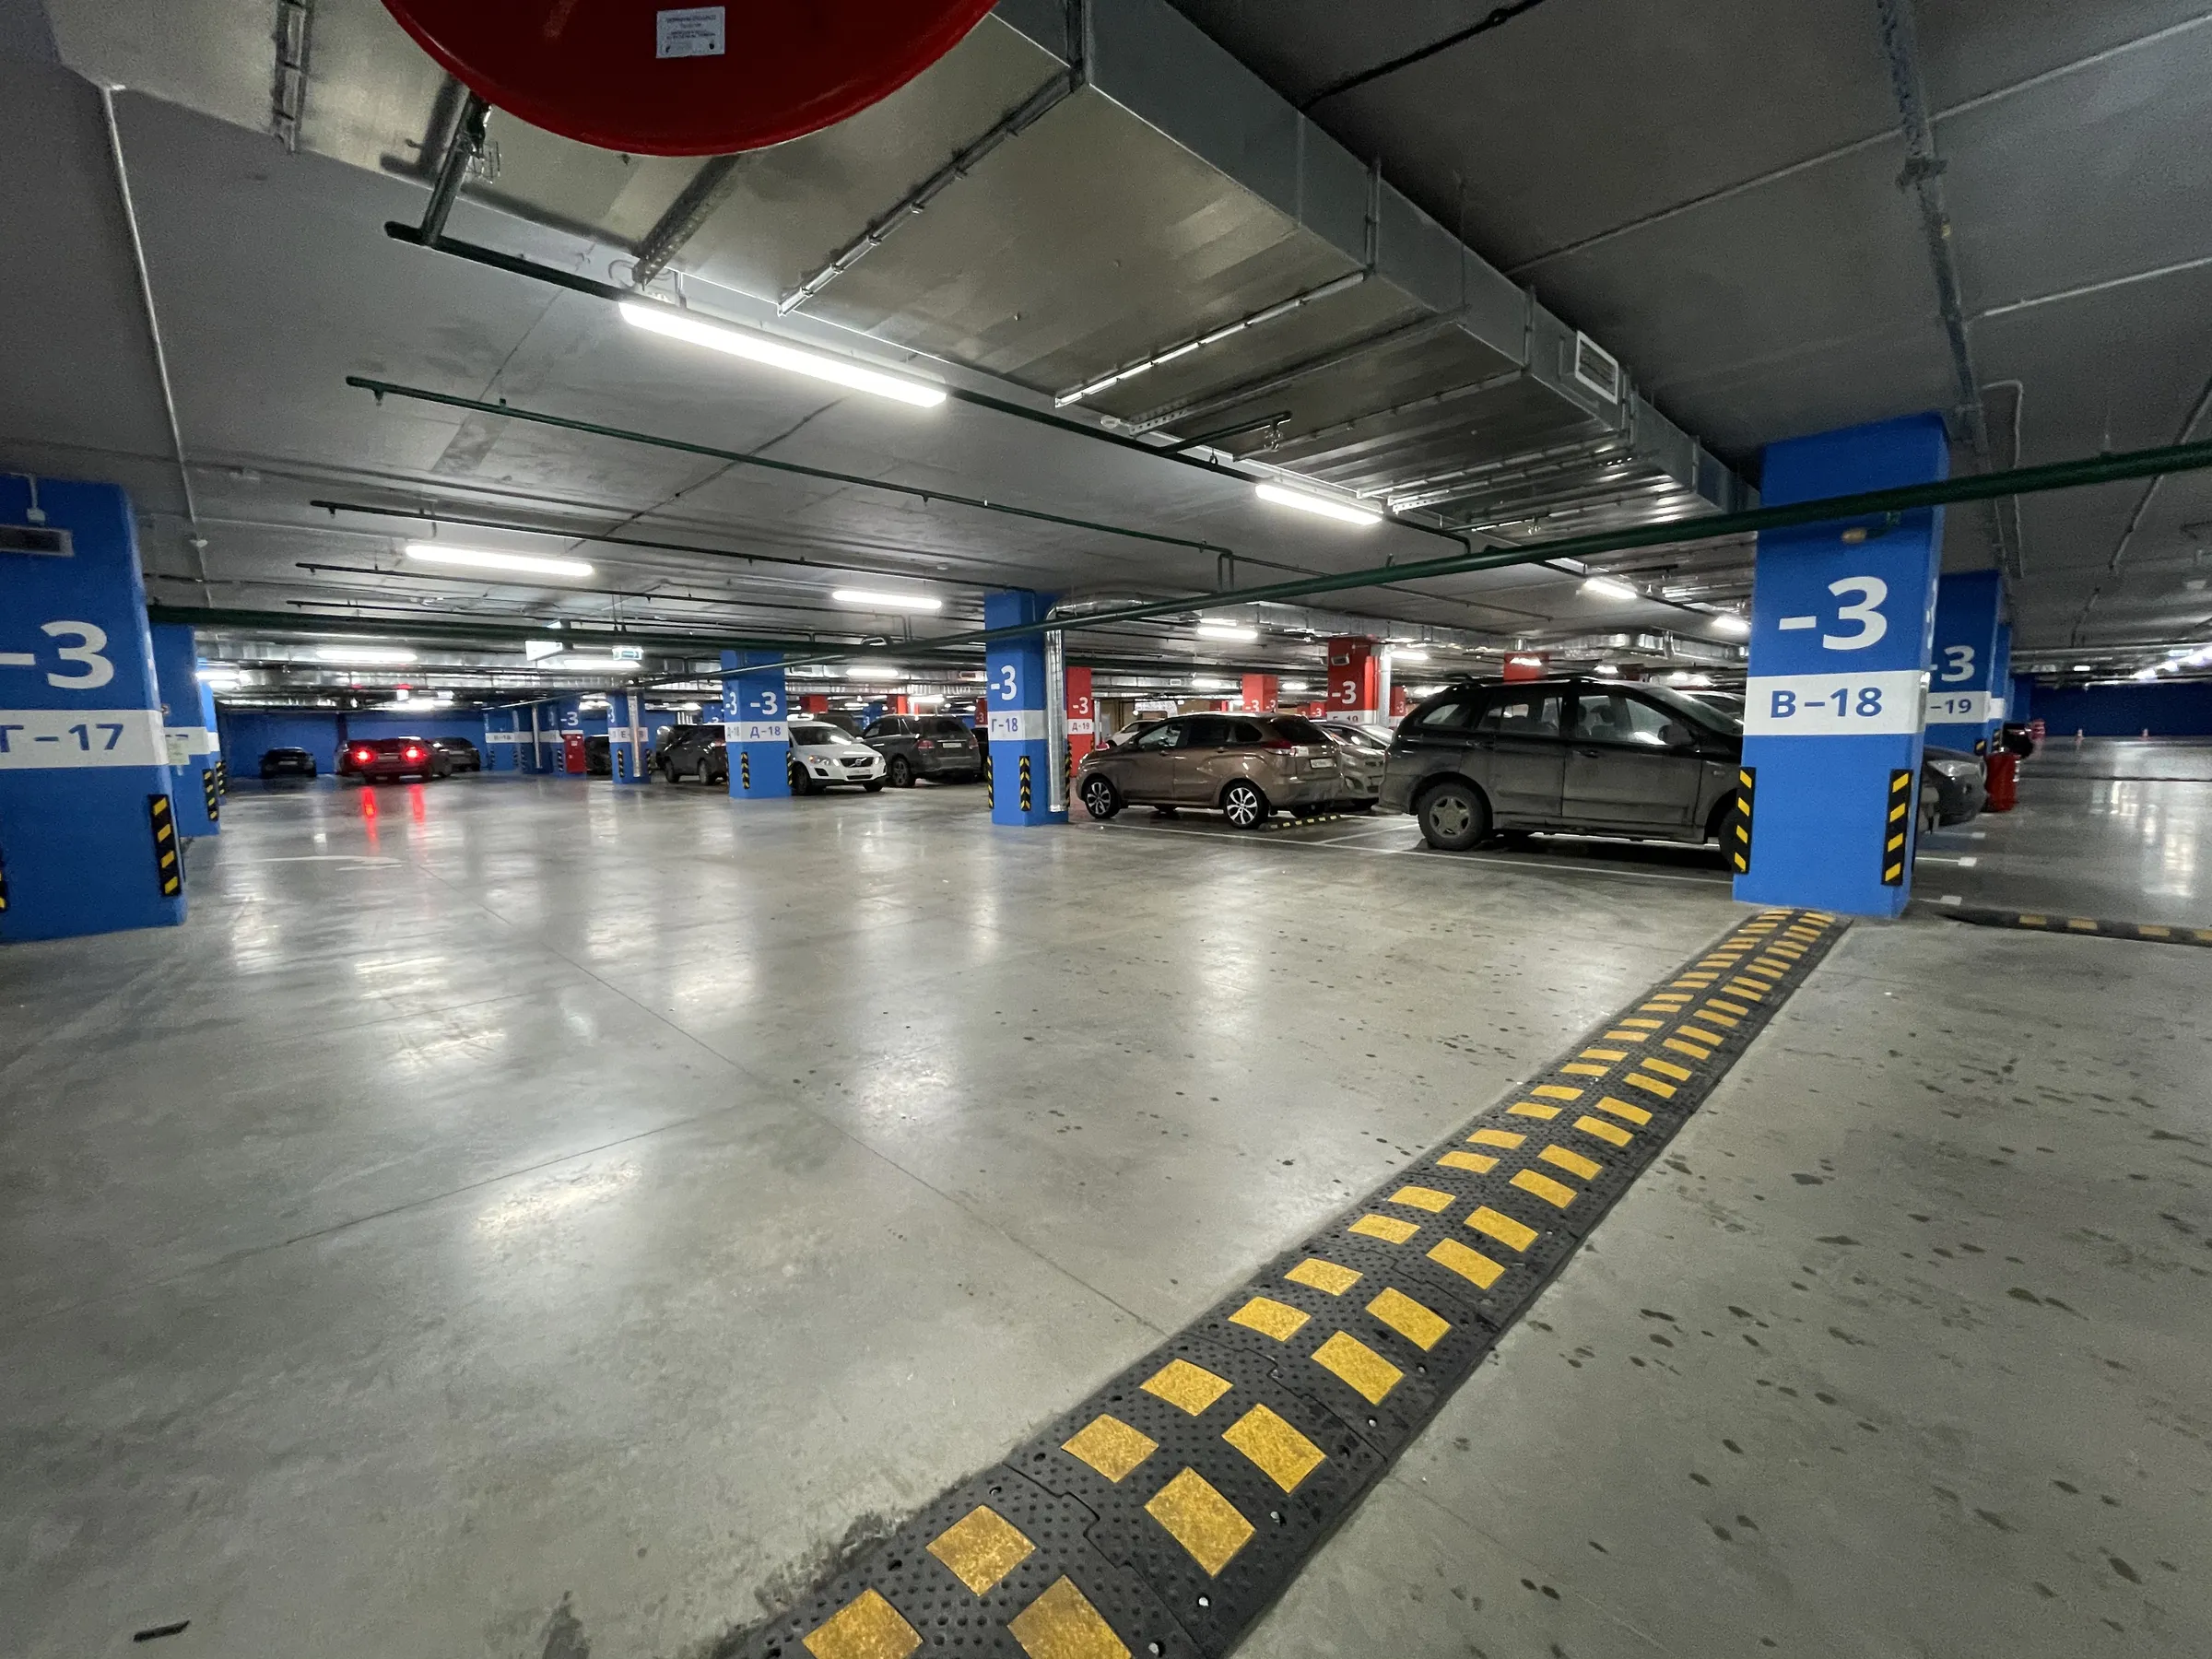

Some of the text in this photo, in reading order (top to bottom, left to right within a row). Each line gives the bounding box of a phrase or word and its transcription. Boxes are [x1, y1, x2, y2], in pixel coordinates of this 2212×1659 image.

[1779, 576, 1888, 651] -3
[0, 620, 114, 689] -3
[990, 665, 1018, 700] -3
[1331, 680, 1357, 704] -3
[725, 691, 737, 715] -3
[750, 691, 778, 715] -3
[1072, 697, 1088, 714] -3
[1771, 687, 1883, 719] В-18
[559, 712, 579, 726] -3
[992, 717, 1018, 733] Г-18
[1072, 722, 1090, 732] Д-19
[0, 724, 124, 753] Г-17
[750, 726, 782, 739] Д-18
